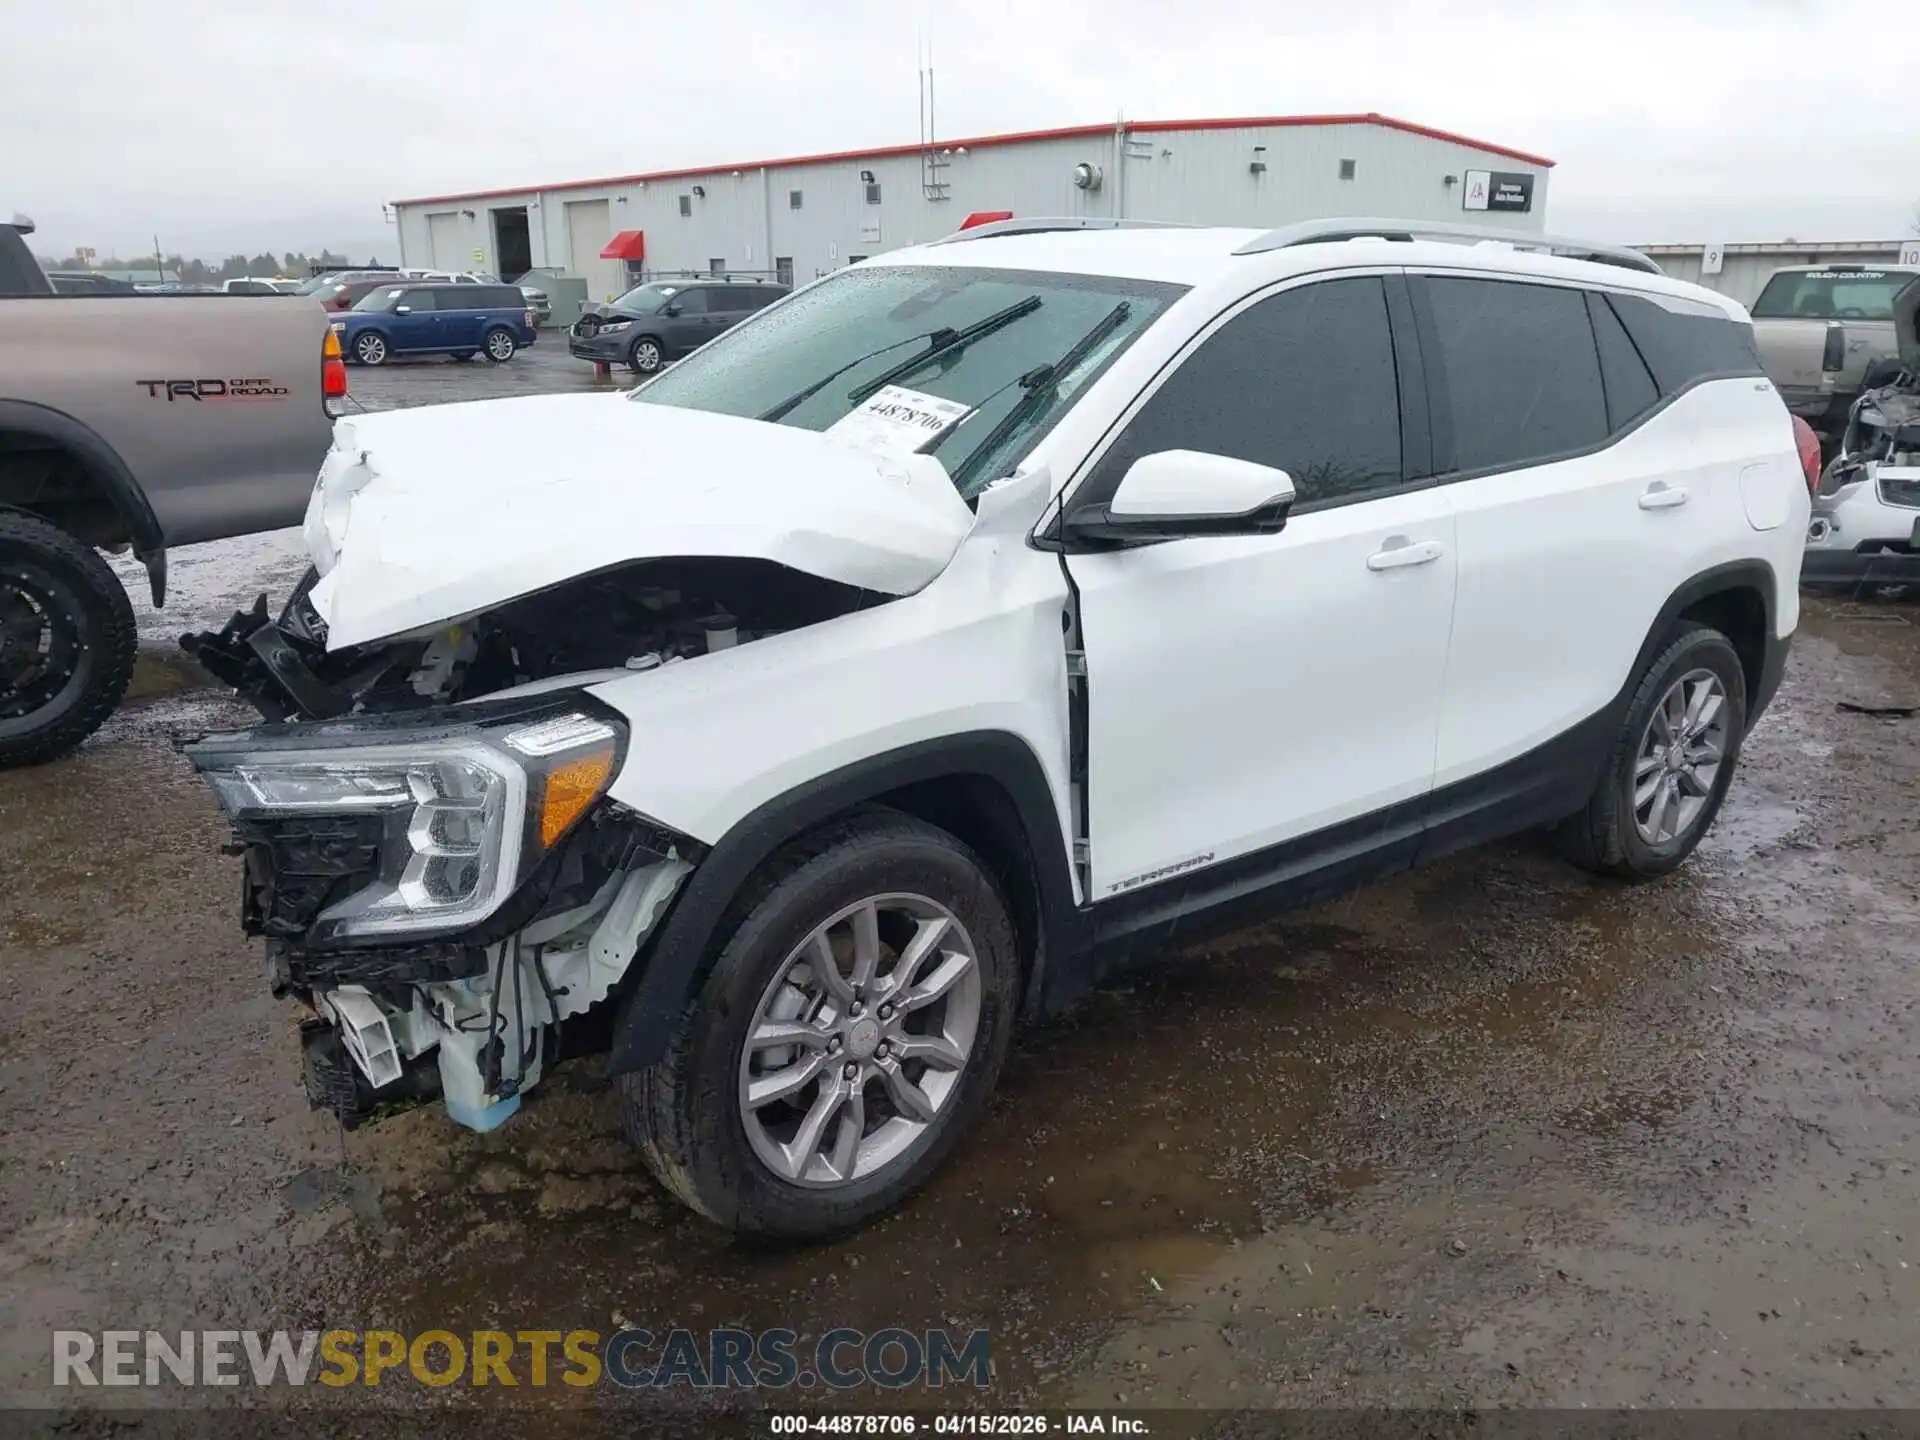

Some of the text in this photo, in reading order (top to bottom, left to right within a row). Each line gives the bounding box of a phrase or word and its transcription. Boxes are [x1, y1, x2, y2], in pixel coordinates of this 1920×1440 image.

[1710, 251, 1718, 265] 9
[1904, 250, 1919, 265] 10
[230, 378, 272, 386] OFF
[136, 379, 227, 402] TRD
[230, 387, 289, 396] ROAD
[869, 403, 944, 430] 44878706
